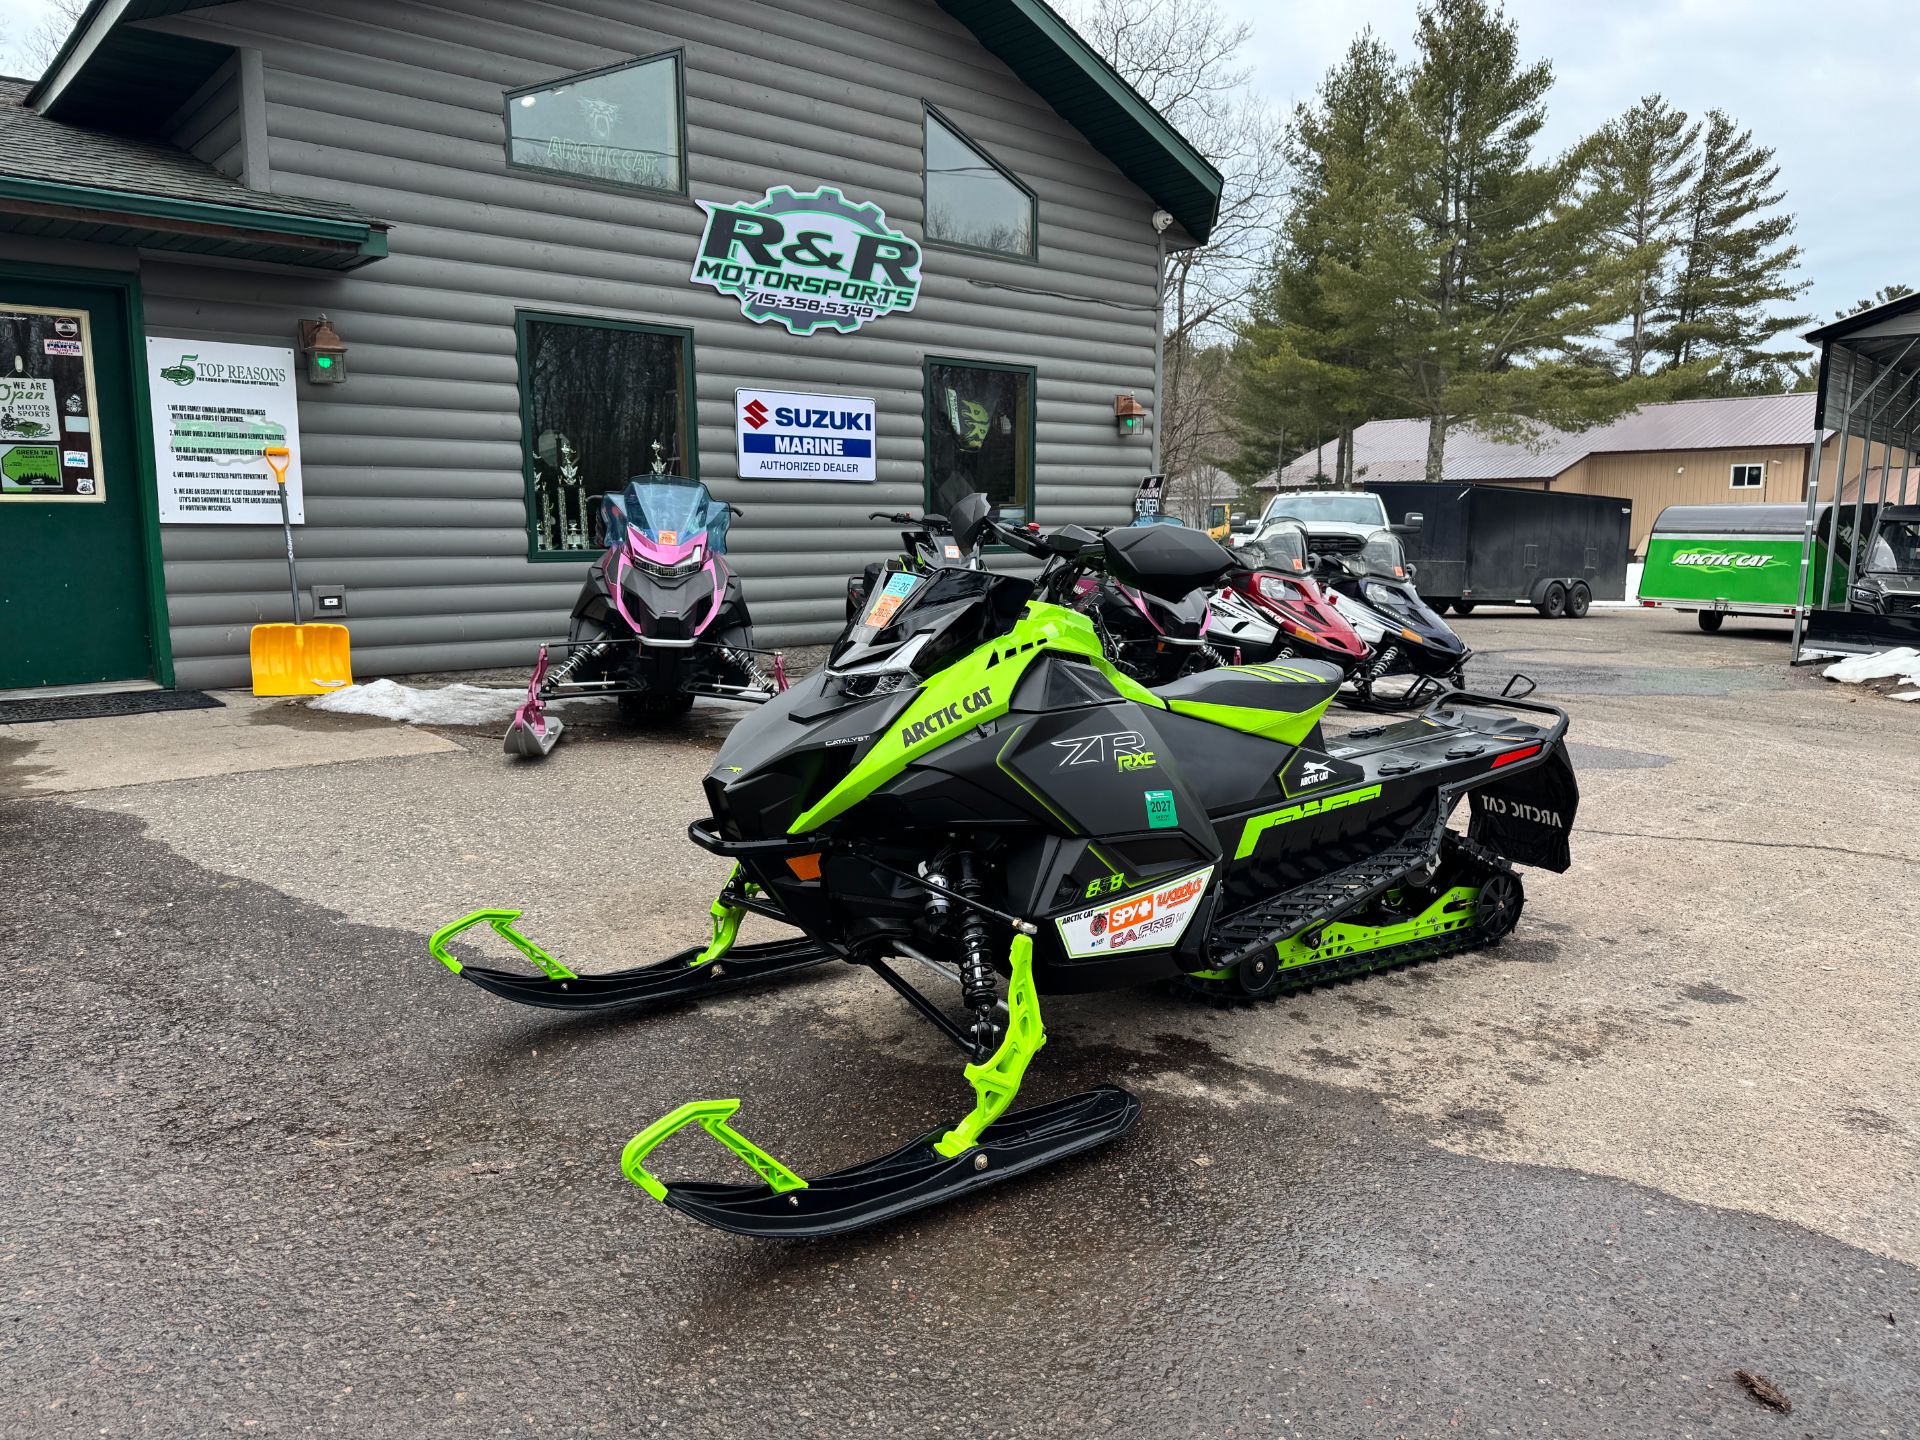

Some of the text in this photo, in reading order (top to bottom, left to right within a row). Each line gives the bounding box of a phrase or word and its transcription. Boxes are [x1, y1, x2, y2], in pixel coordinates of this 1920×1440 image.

[547, 136, 657, 174] ARCTIC CAT
[703, 207, 919, 288] R&R
[696, 260, 914, 307] MOTORSPORTS
[745, 290, 873, 318] 715-358-5349
[197, 362, 224, 378] TOP
[228, 365, 286, 383] REASONS
[13, 382, 47, 391] WE ARE
[17, 404, 50, 412] MOTOR
[775, 407, 872, 431] SUZUKI
[774, 435, 844, 456] MARINE
[760, 460, 859, 473] AUTHORIZED DEALER
[1136, 498, 1160, 512] BETWEEN
[1671, 553, 1774, 567] ARCTIC CAT
[902, 686, 993, 748] ARCTIC CAT
[825, 735, 870, 747] CATALYST
[1050, 731, 1146, 767] ZR
[1117, 751, 1157, 773] RXC
[1300, 770, 1329, 787] ARCTIC CAT
[1150, 800, 1171, 813] 2027
[1085, 872, 1125, 899] 858
[1061, 912, 1083, 926] ARCTIC
[1083, 909, 1095, 919] CAT
